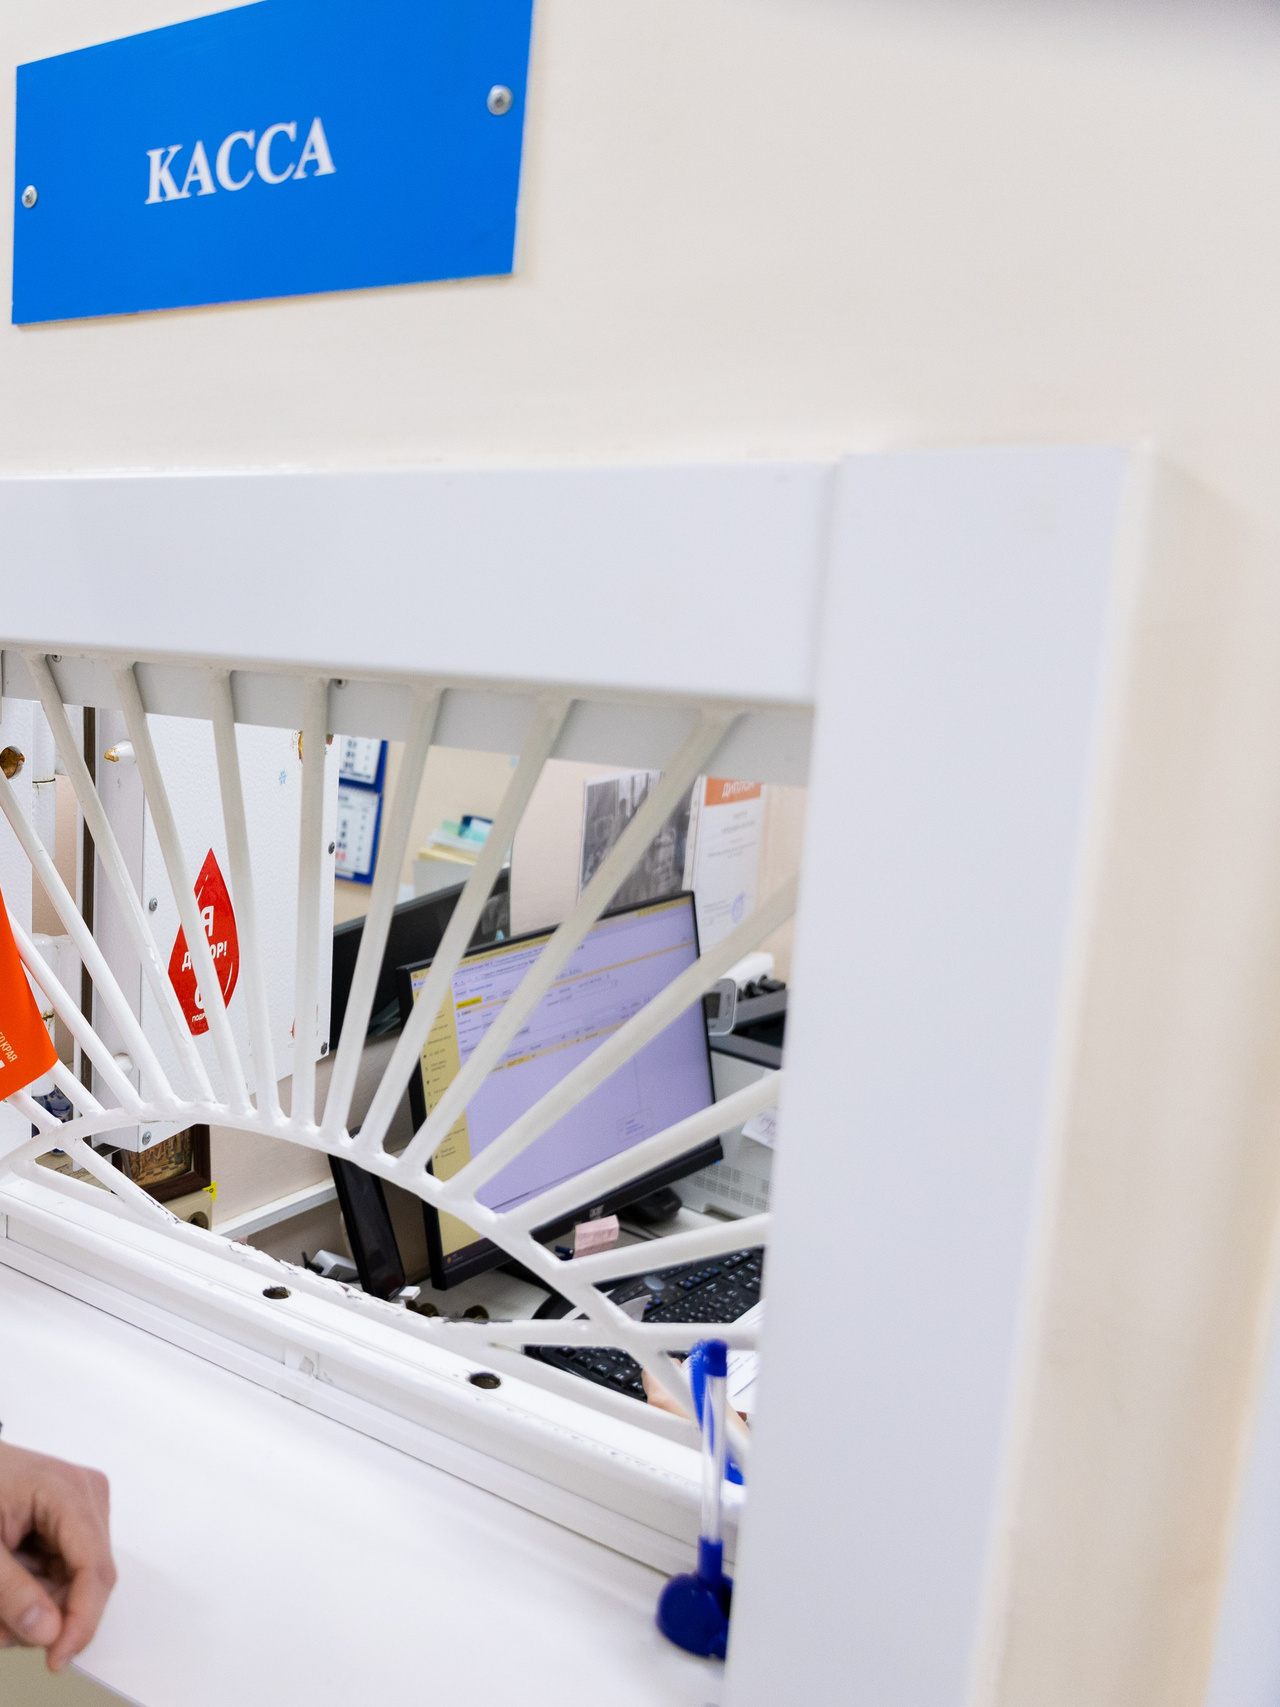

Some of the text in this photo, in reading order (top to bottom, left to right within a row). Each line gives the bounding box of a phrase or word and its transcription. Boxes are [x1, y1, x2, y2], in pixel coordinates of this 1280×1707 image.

[145, 117, 336, 204] КАССА
[199, 905, 214, 937] Я
[181, 940, 228, 972] ДОР!
[0, 1041, 18, 1063] КРАЯ
